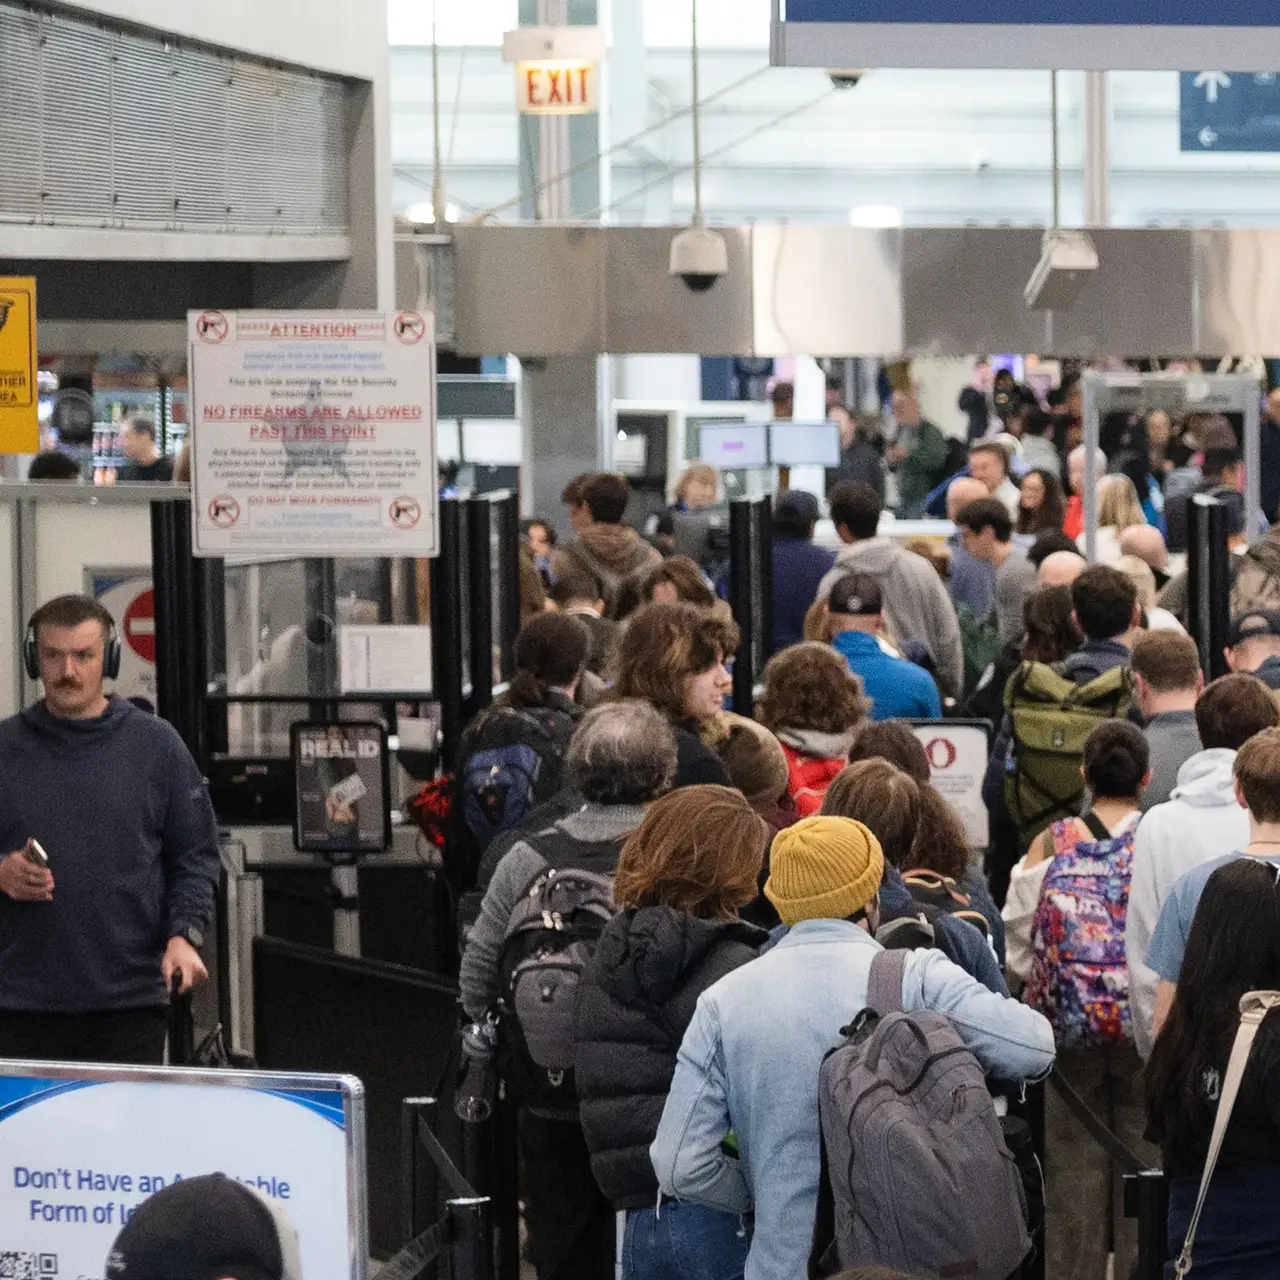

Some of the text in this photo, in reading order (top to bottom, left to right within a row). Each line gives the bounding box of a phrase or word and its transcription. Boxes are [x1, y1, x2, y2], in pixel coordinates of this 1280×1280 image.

[526, 67, 590, 104] EXIT
[269, 323, 357, 338] ATTENTION
[204, 405, 422, 420] NO FIREARMS ARE ALLOWED
[250, 425, 377, 440] PAST THIS POINT
[300, 740, 380, 758] REAL ID
[13, 1166, 72, 1191] Don't
[76, 1169, 132, 1193] Have
[138, 1176, 166, 1194] an
[29, 1199, 87, 1223] Form
[92, 1202, 115, 1225] of
